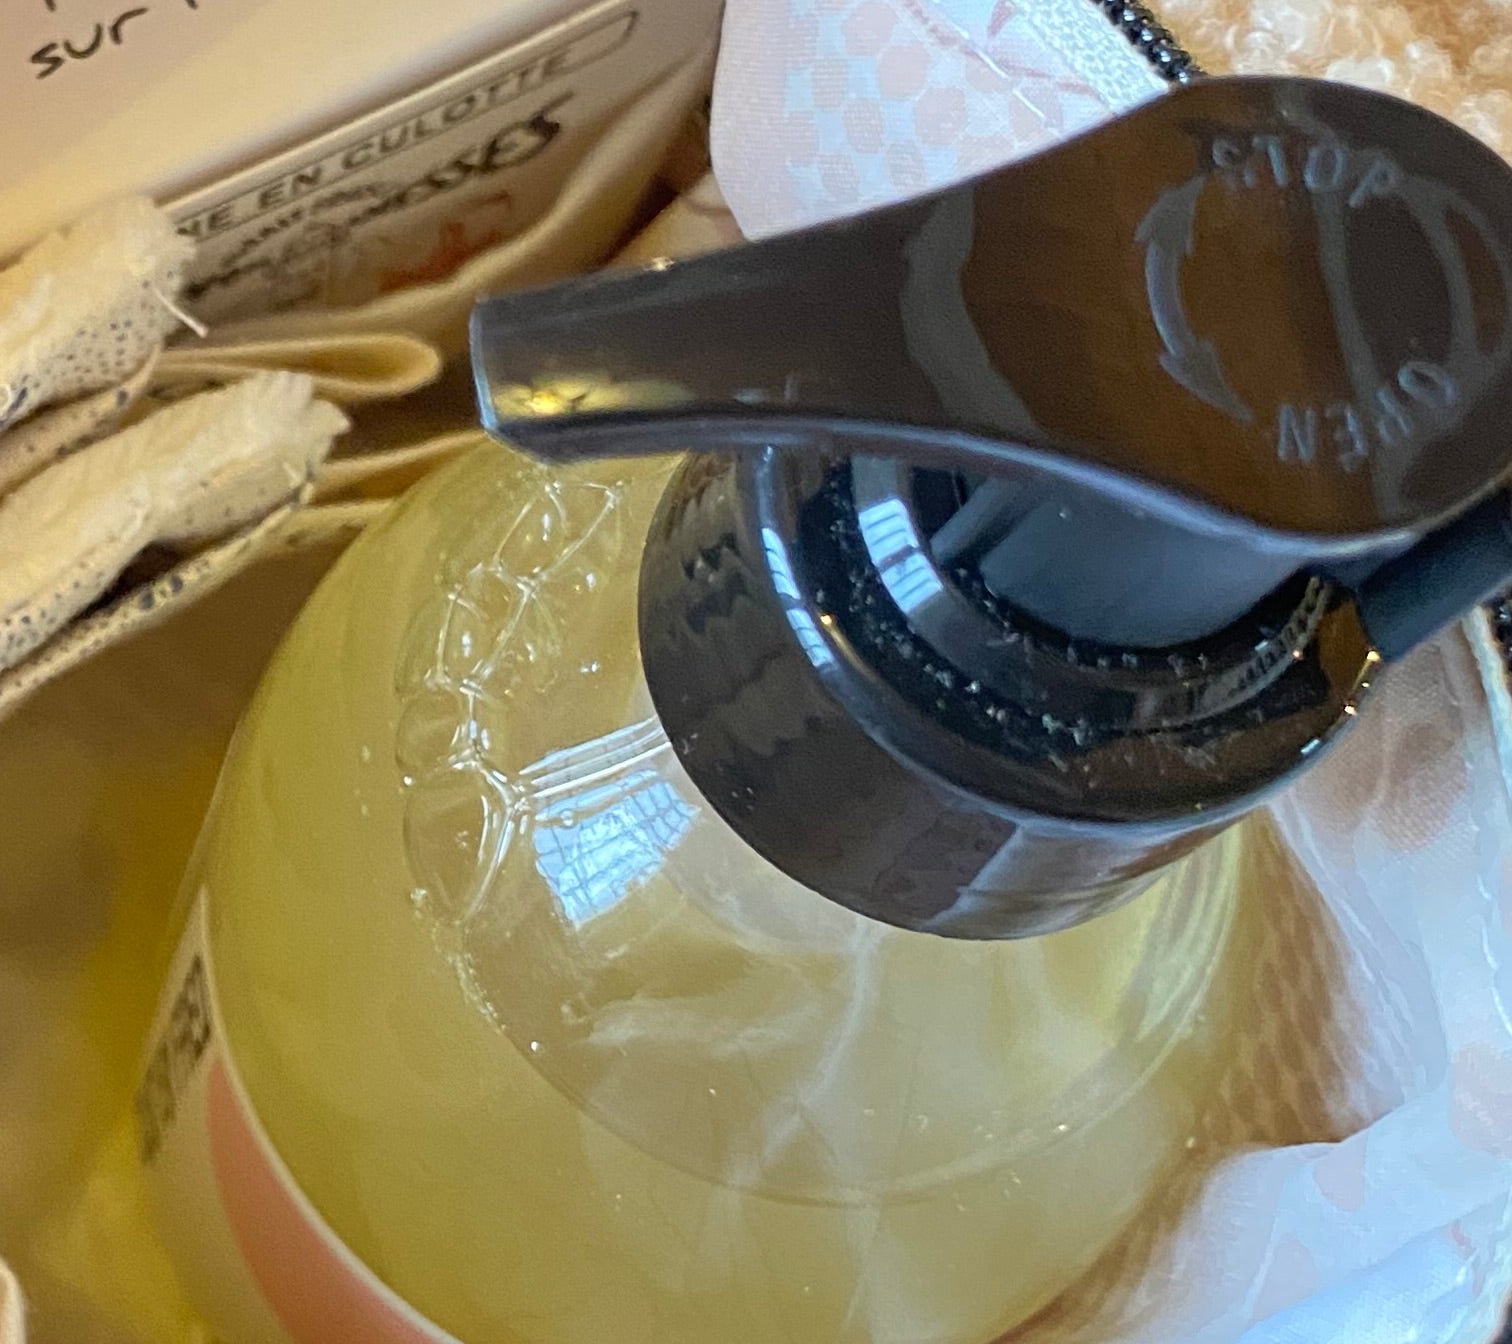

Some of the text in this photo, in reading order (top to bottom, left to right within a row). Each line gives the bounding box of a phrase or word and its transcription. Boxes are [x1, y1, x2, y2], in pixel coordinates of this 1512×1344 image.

[29, 7, 149, 79] sur
[256, 168, 324, 211] EN
[340, 52, 574, 171] CULOTTE
[1211, 133, 1403, 209] STOP
